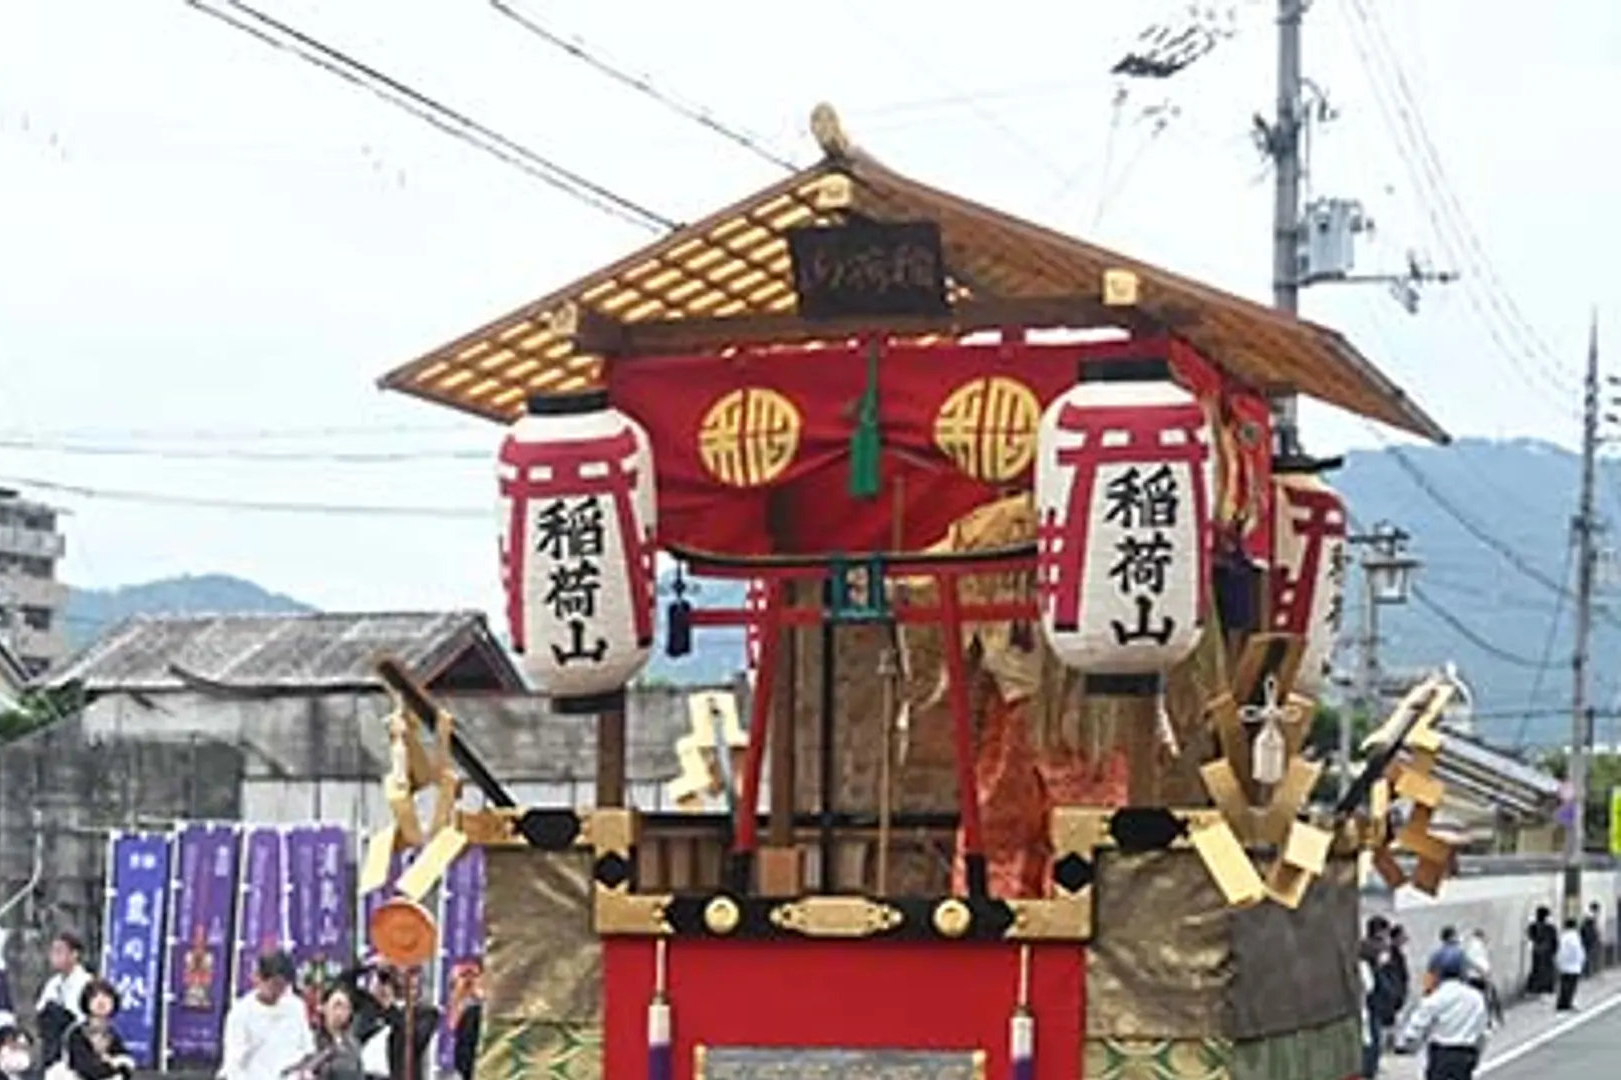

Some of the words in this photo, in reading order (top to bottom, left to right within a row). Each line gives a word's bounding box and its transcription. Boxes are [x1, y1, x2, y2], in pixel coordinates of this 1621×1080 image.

[537, 496, 609, 666] 稲荷山
[1103, 464, 1179, 646] 稲荷山
